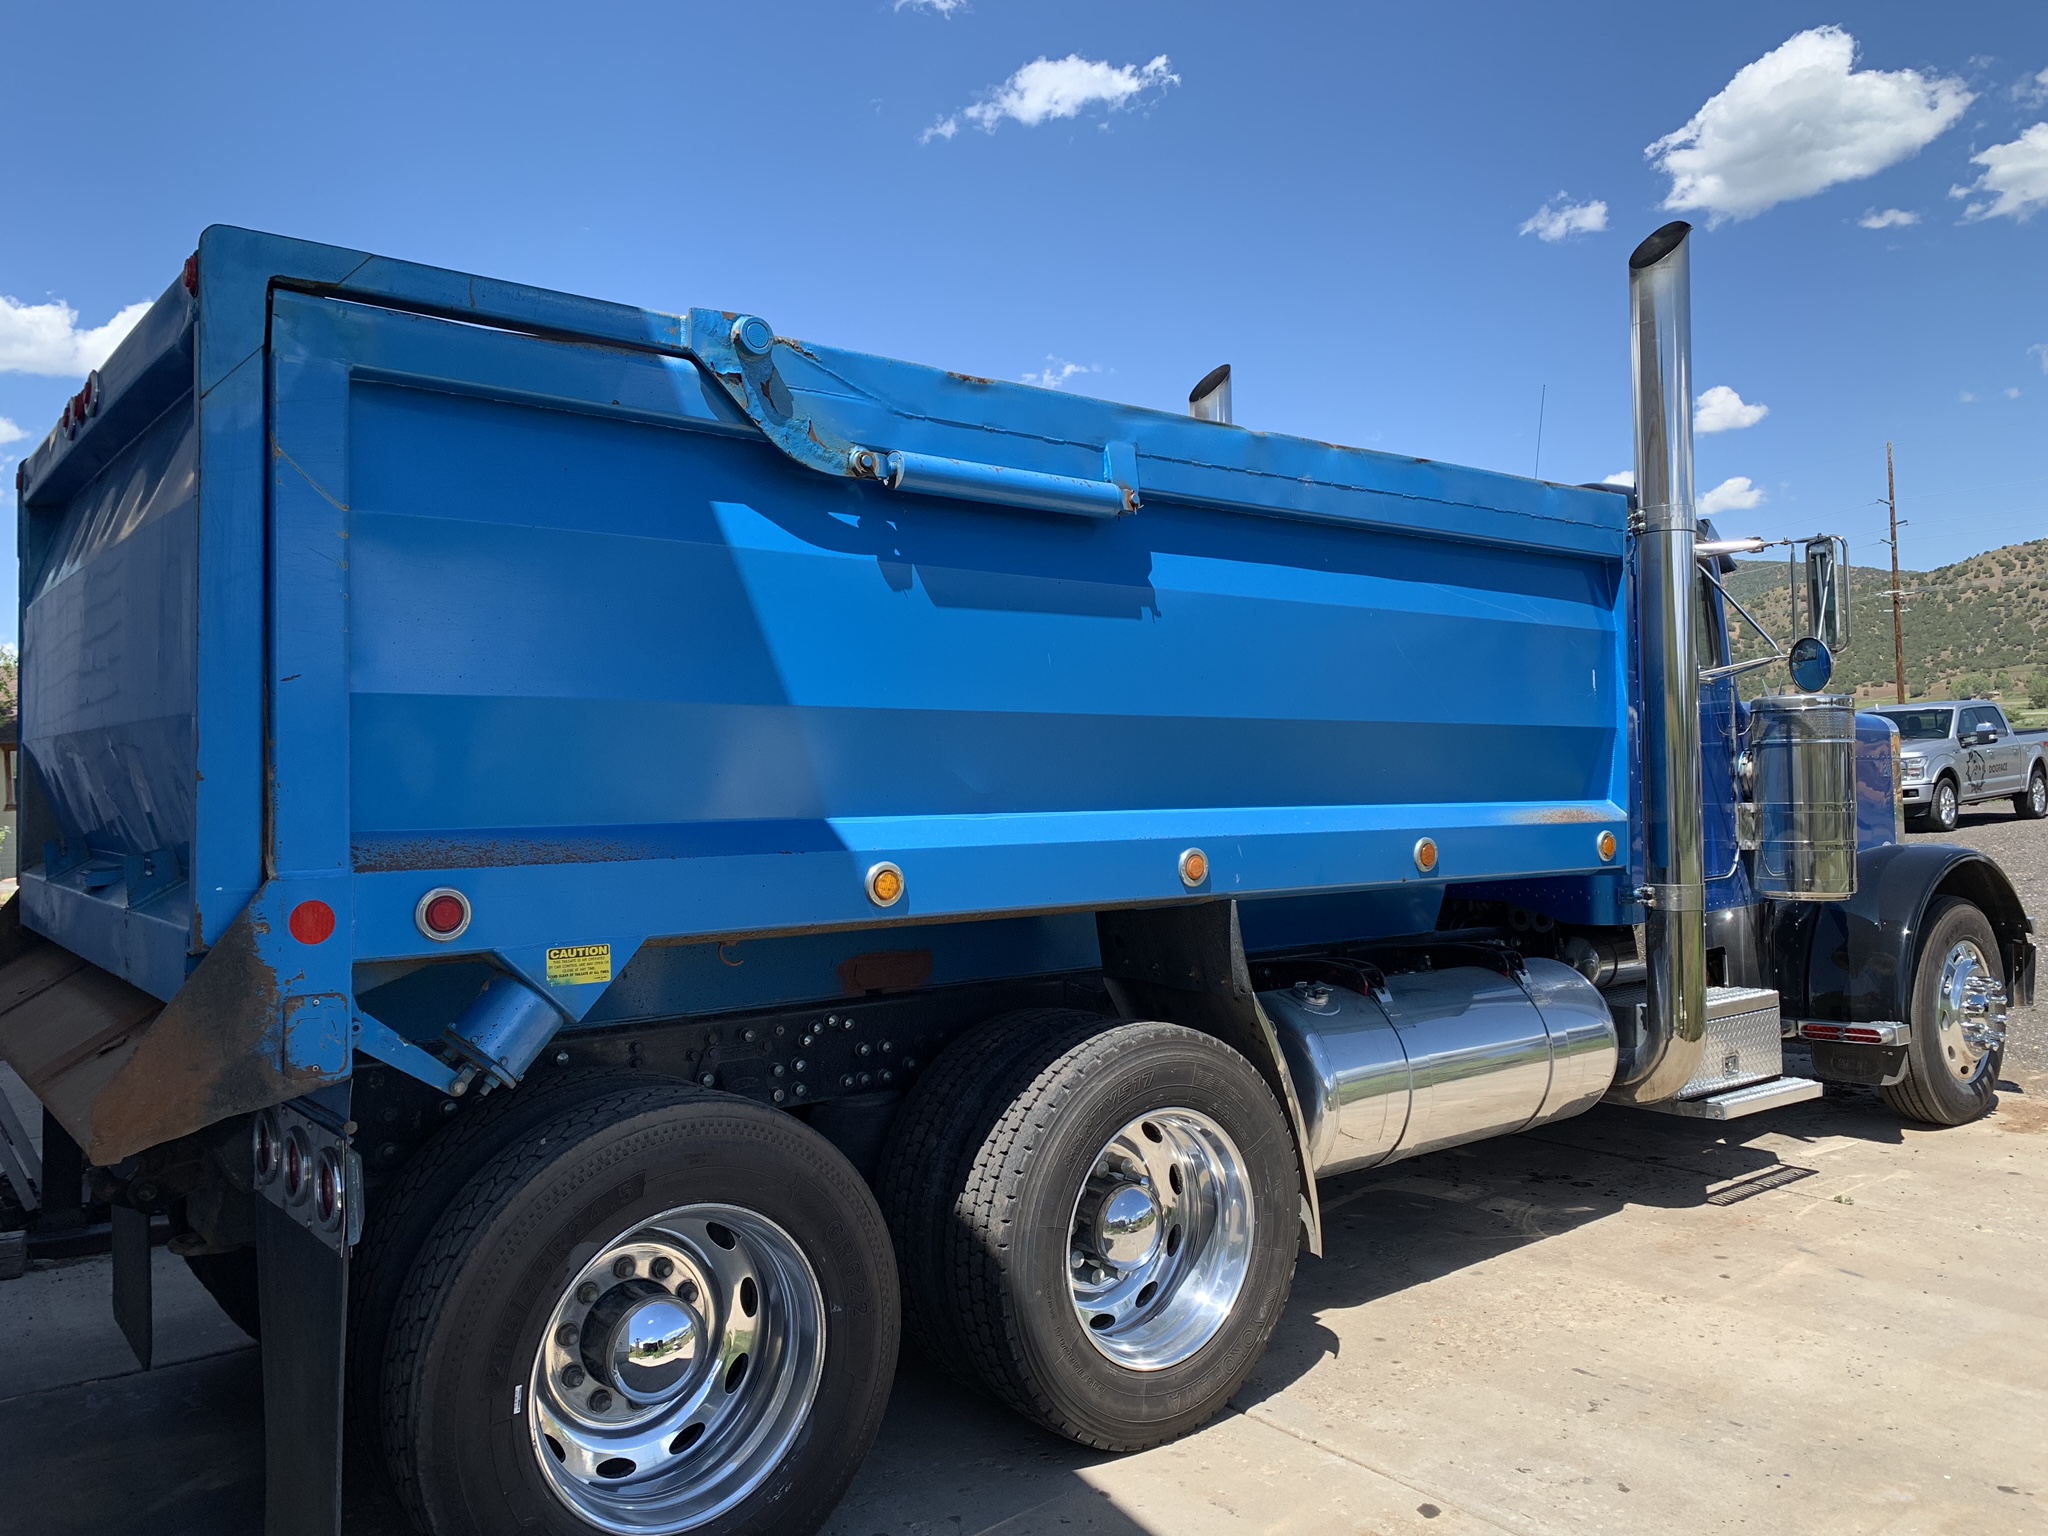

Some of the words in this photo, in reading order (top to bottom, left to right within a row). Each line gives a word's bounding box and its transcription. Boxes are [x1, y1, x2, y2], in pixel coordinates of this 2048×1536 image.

[550, 946, 607, 959] CAUTION
[825, 1219, 869, 1319] GR622
[1167, 1317, 1266, 1412] YOKOHAMA
